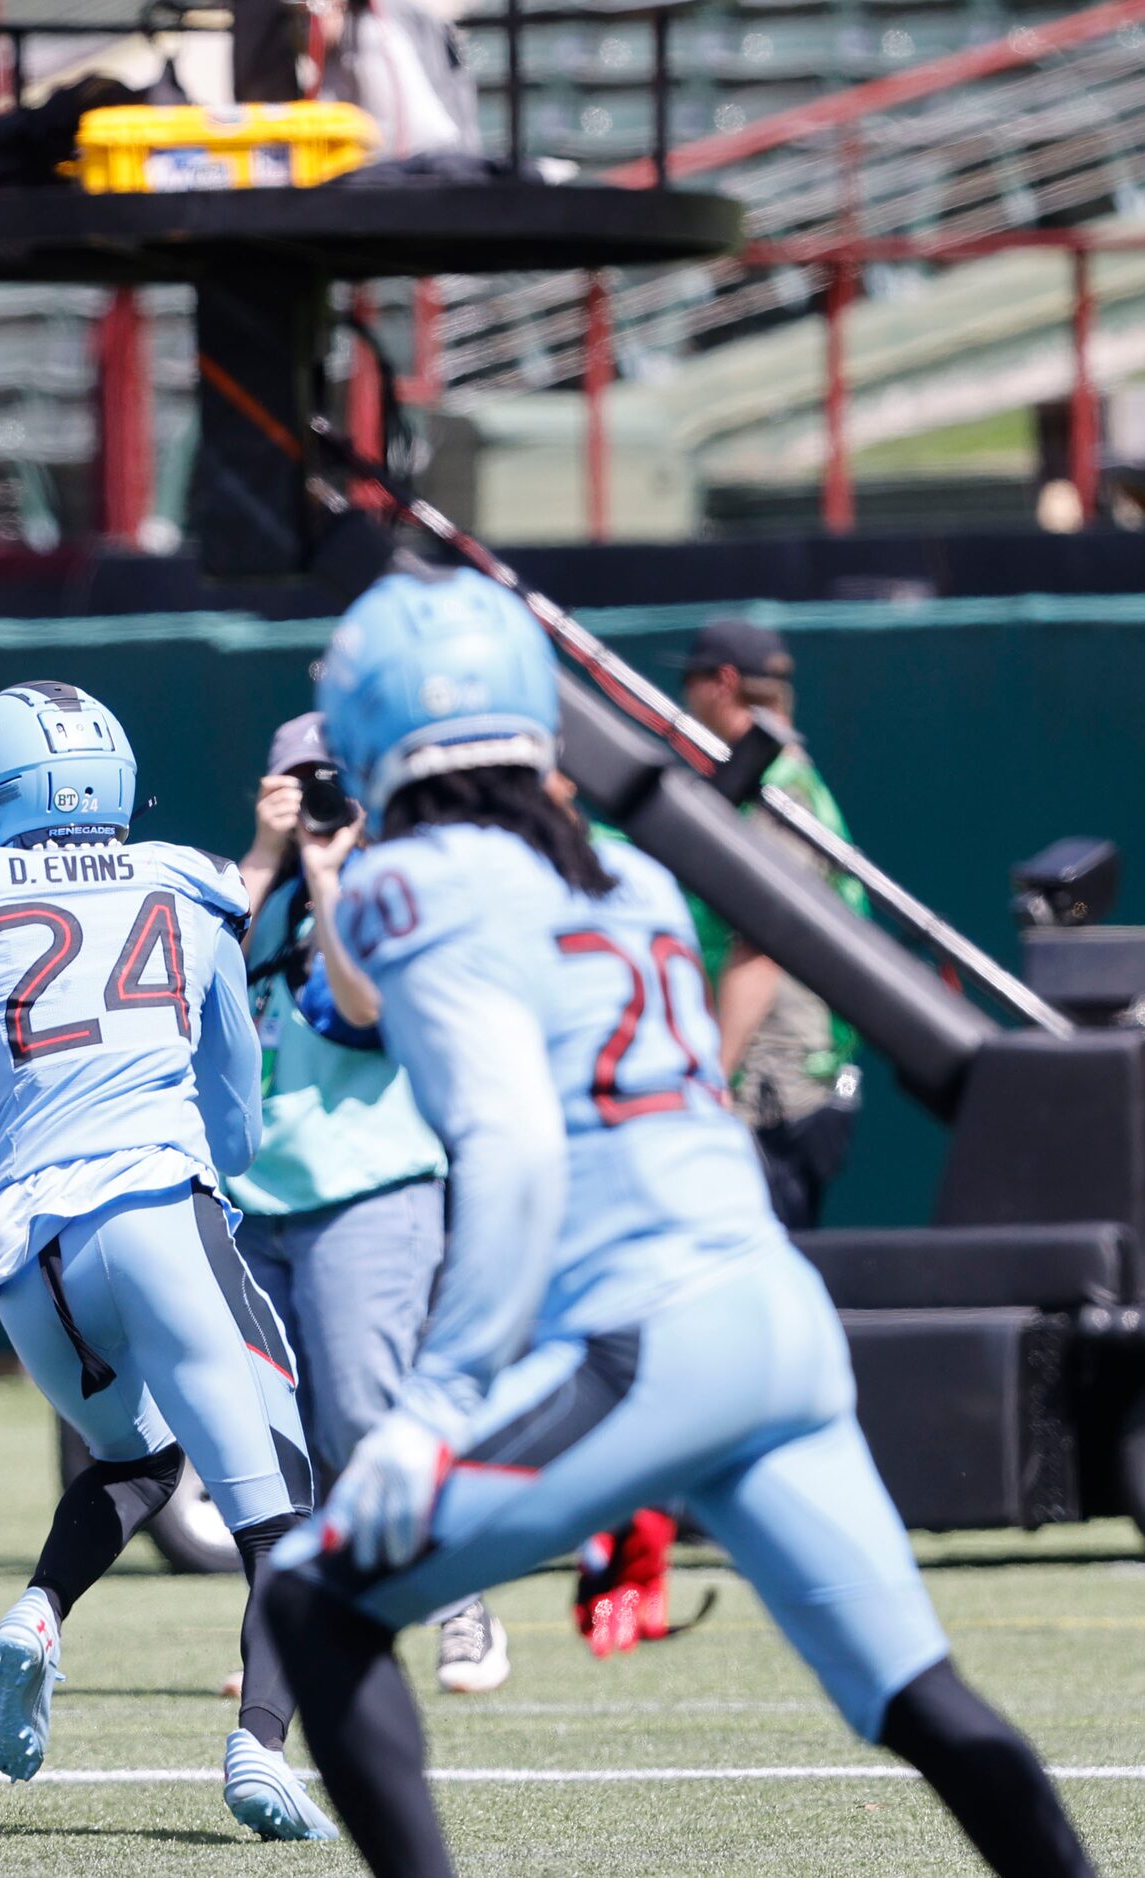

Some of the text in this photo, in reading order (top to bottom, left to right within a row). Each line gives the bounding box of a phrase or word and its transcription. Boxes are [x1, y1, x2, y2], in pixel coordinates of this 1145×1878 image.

[57, 794, 99, 813] BT 24
[48, 826, 116, 837] RENEGADES
[8, 853, 135, 884] D. EVANS
[555, 928, 726, 1128] 20
